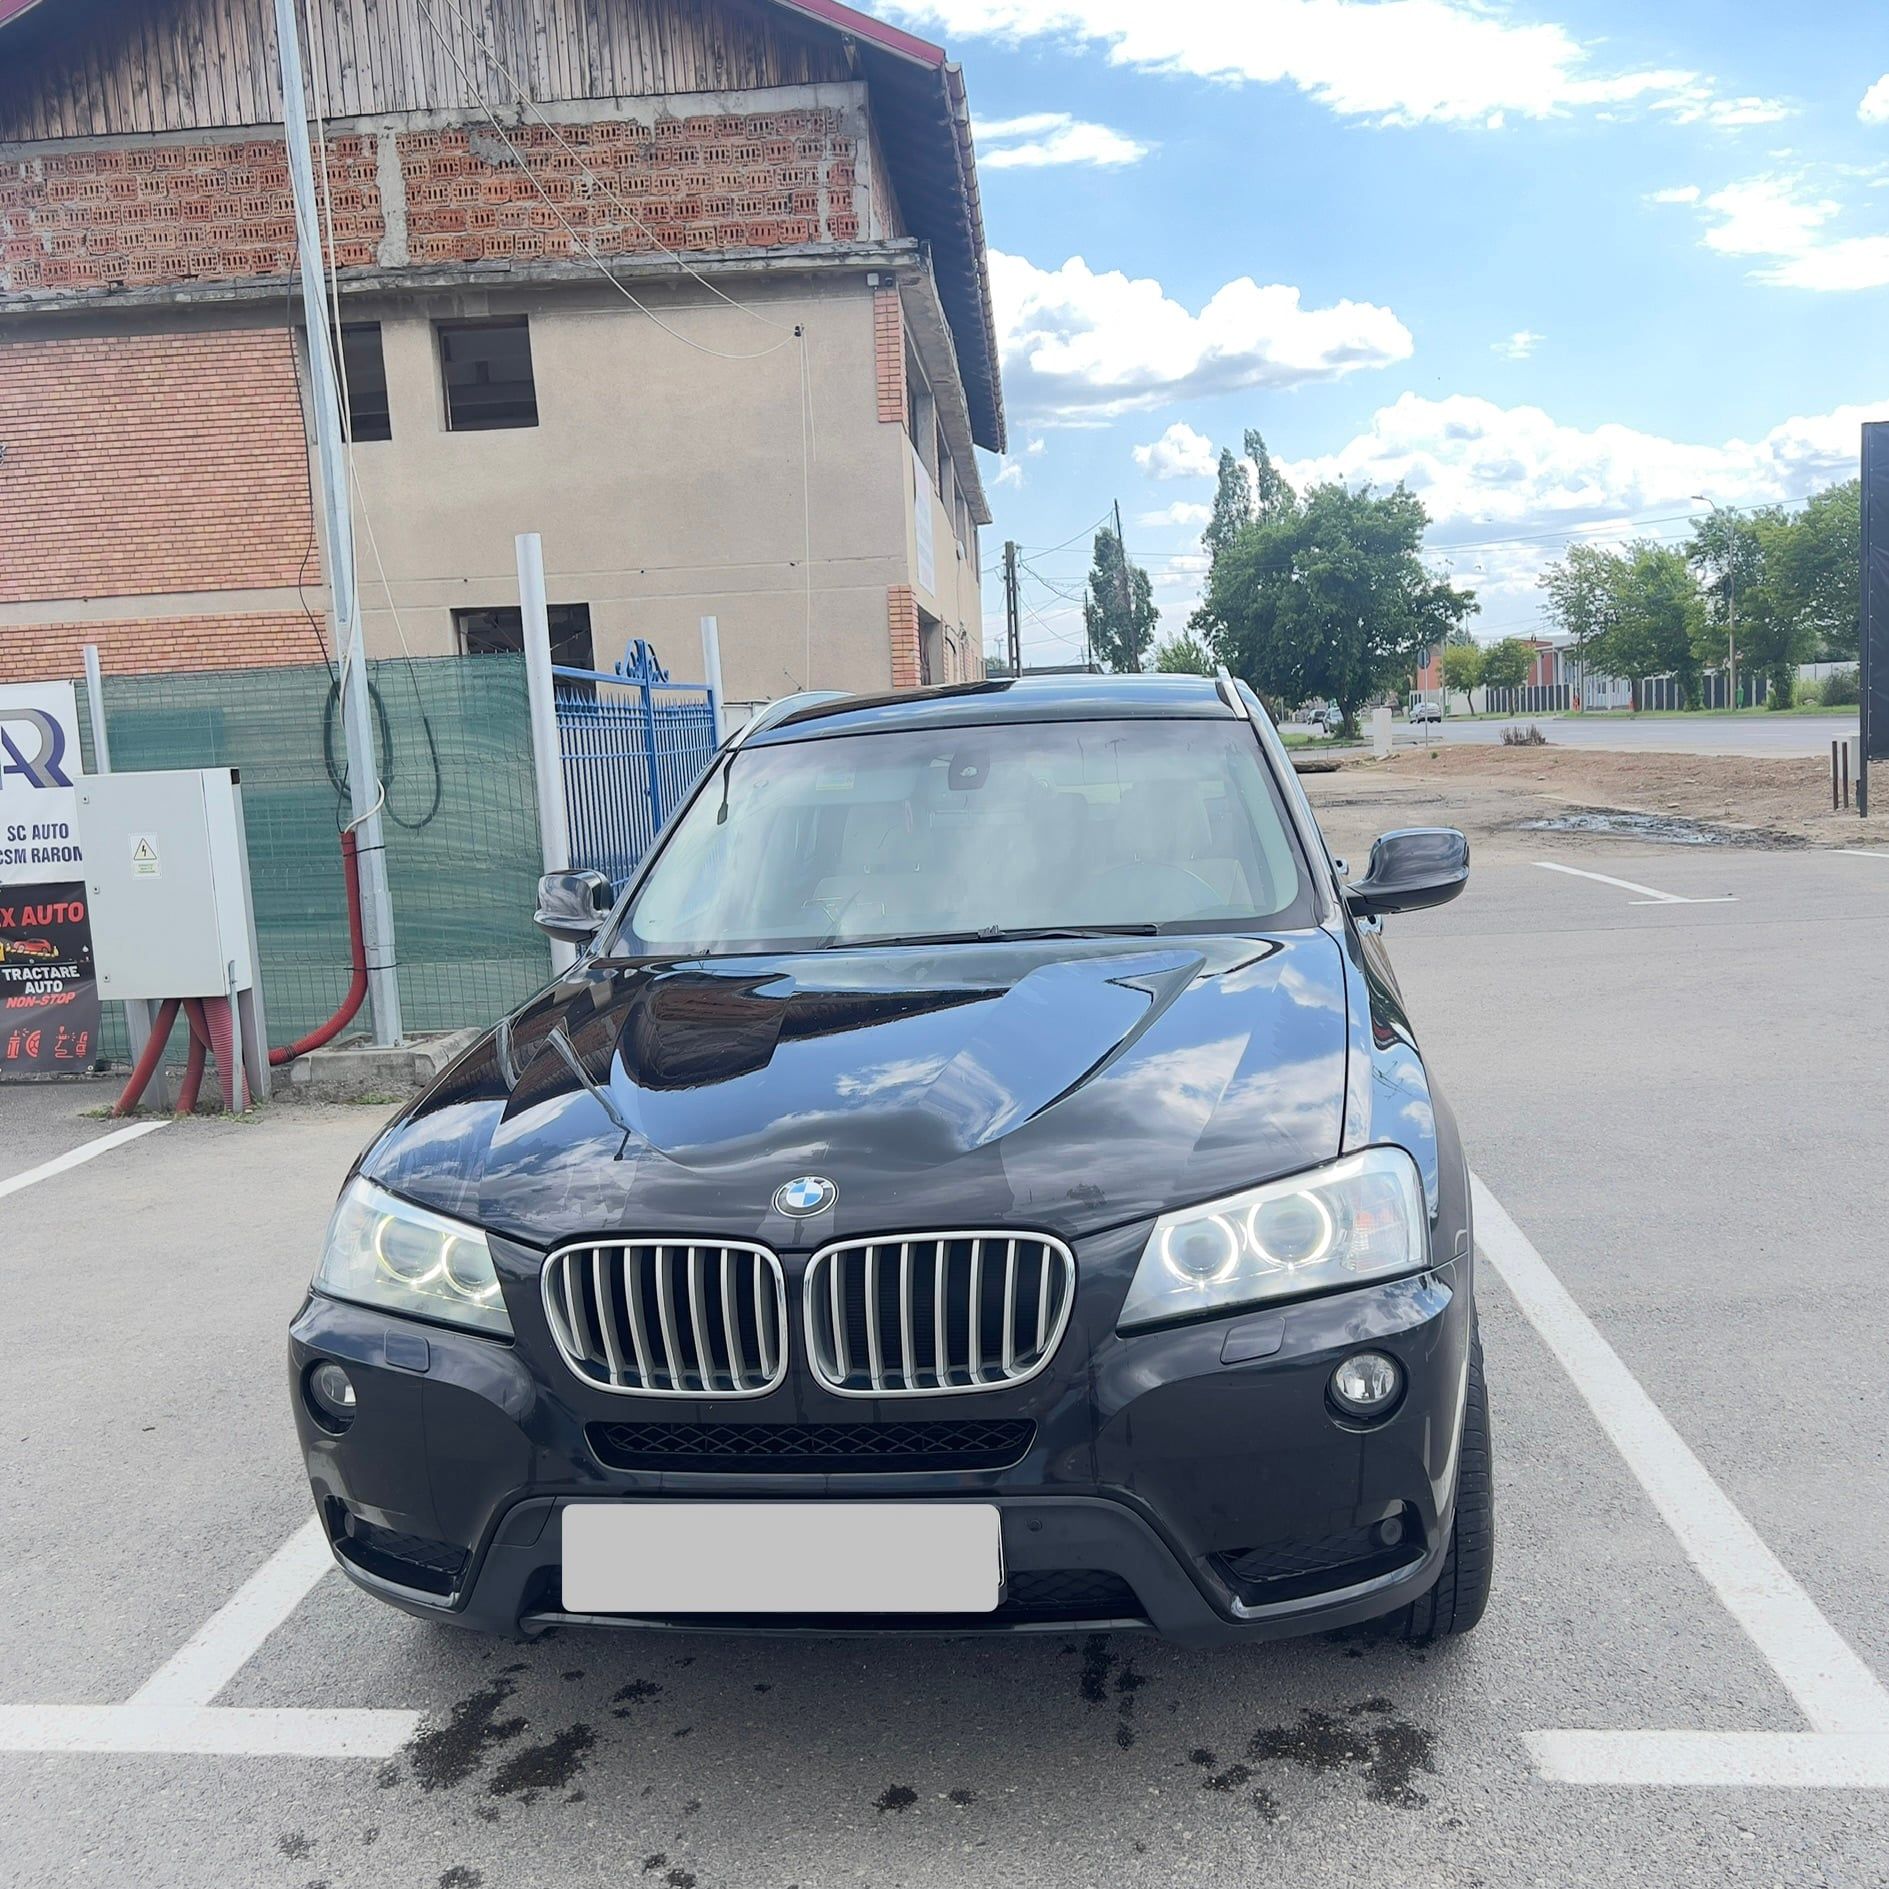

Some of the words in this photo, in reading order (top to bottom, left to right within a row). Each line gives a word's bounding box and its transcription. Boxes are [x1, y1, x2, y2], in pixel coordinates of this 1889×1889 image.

[7, 825, 27, 842] SC
[32, 823, 69, 840] AUTO
[0, 907, 16, 928] X
[21, 901, 85, 926] AUTO
[2, 965, 80, 981] TRACTARE
[25, 981, 63, 994] AUTO
[6, 992, 76, 1008] NON-STOP
